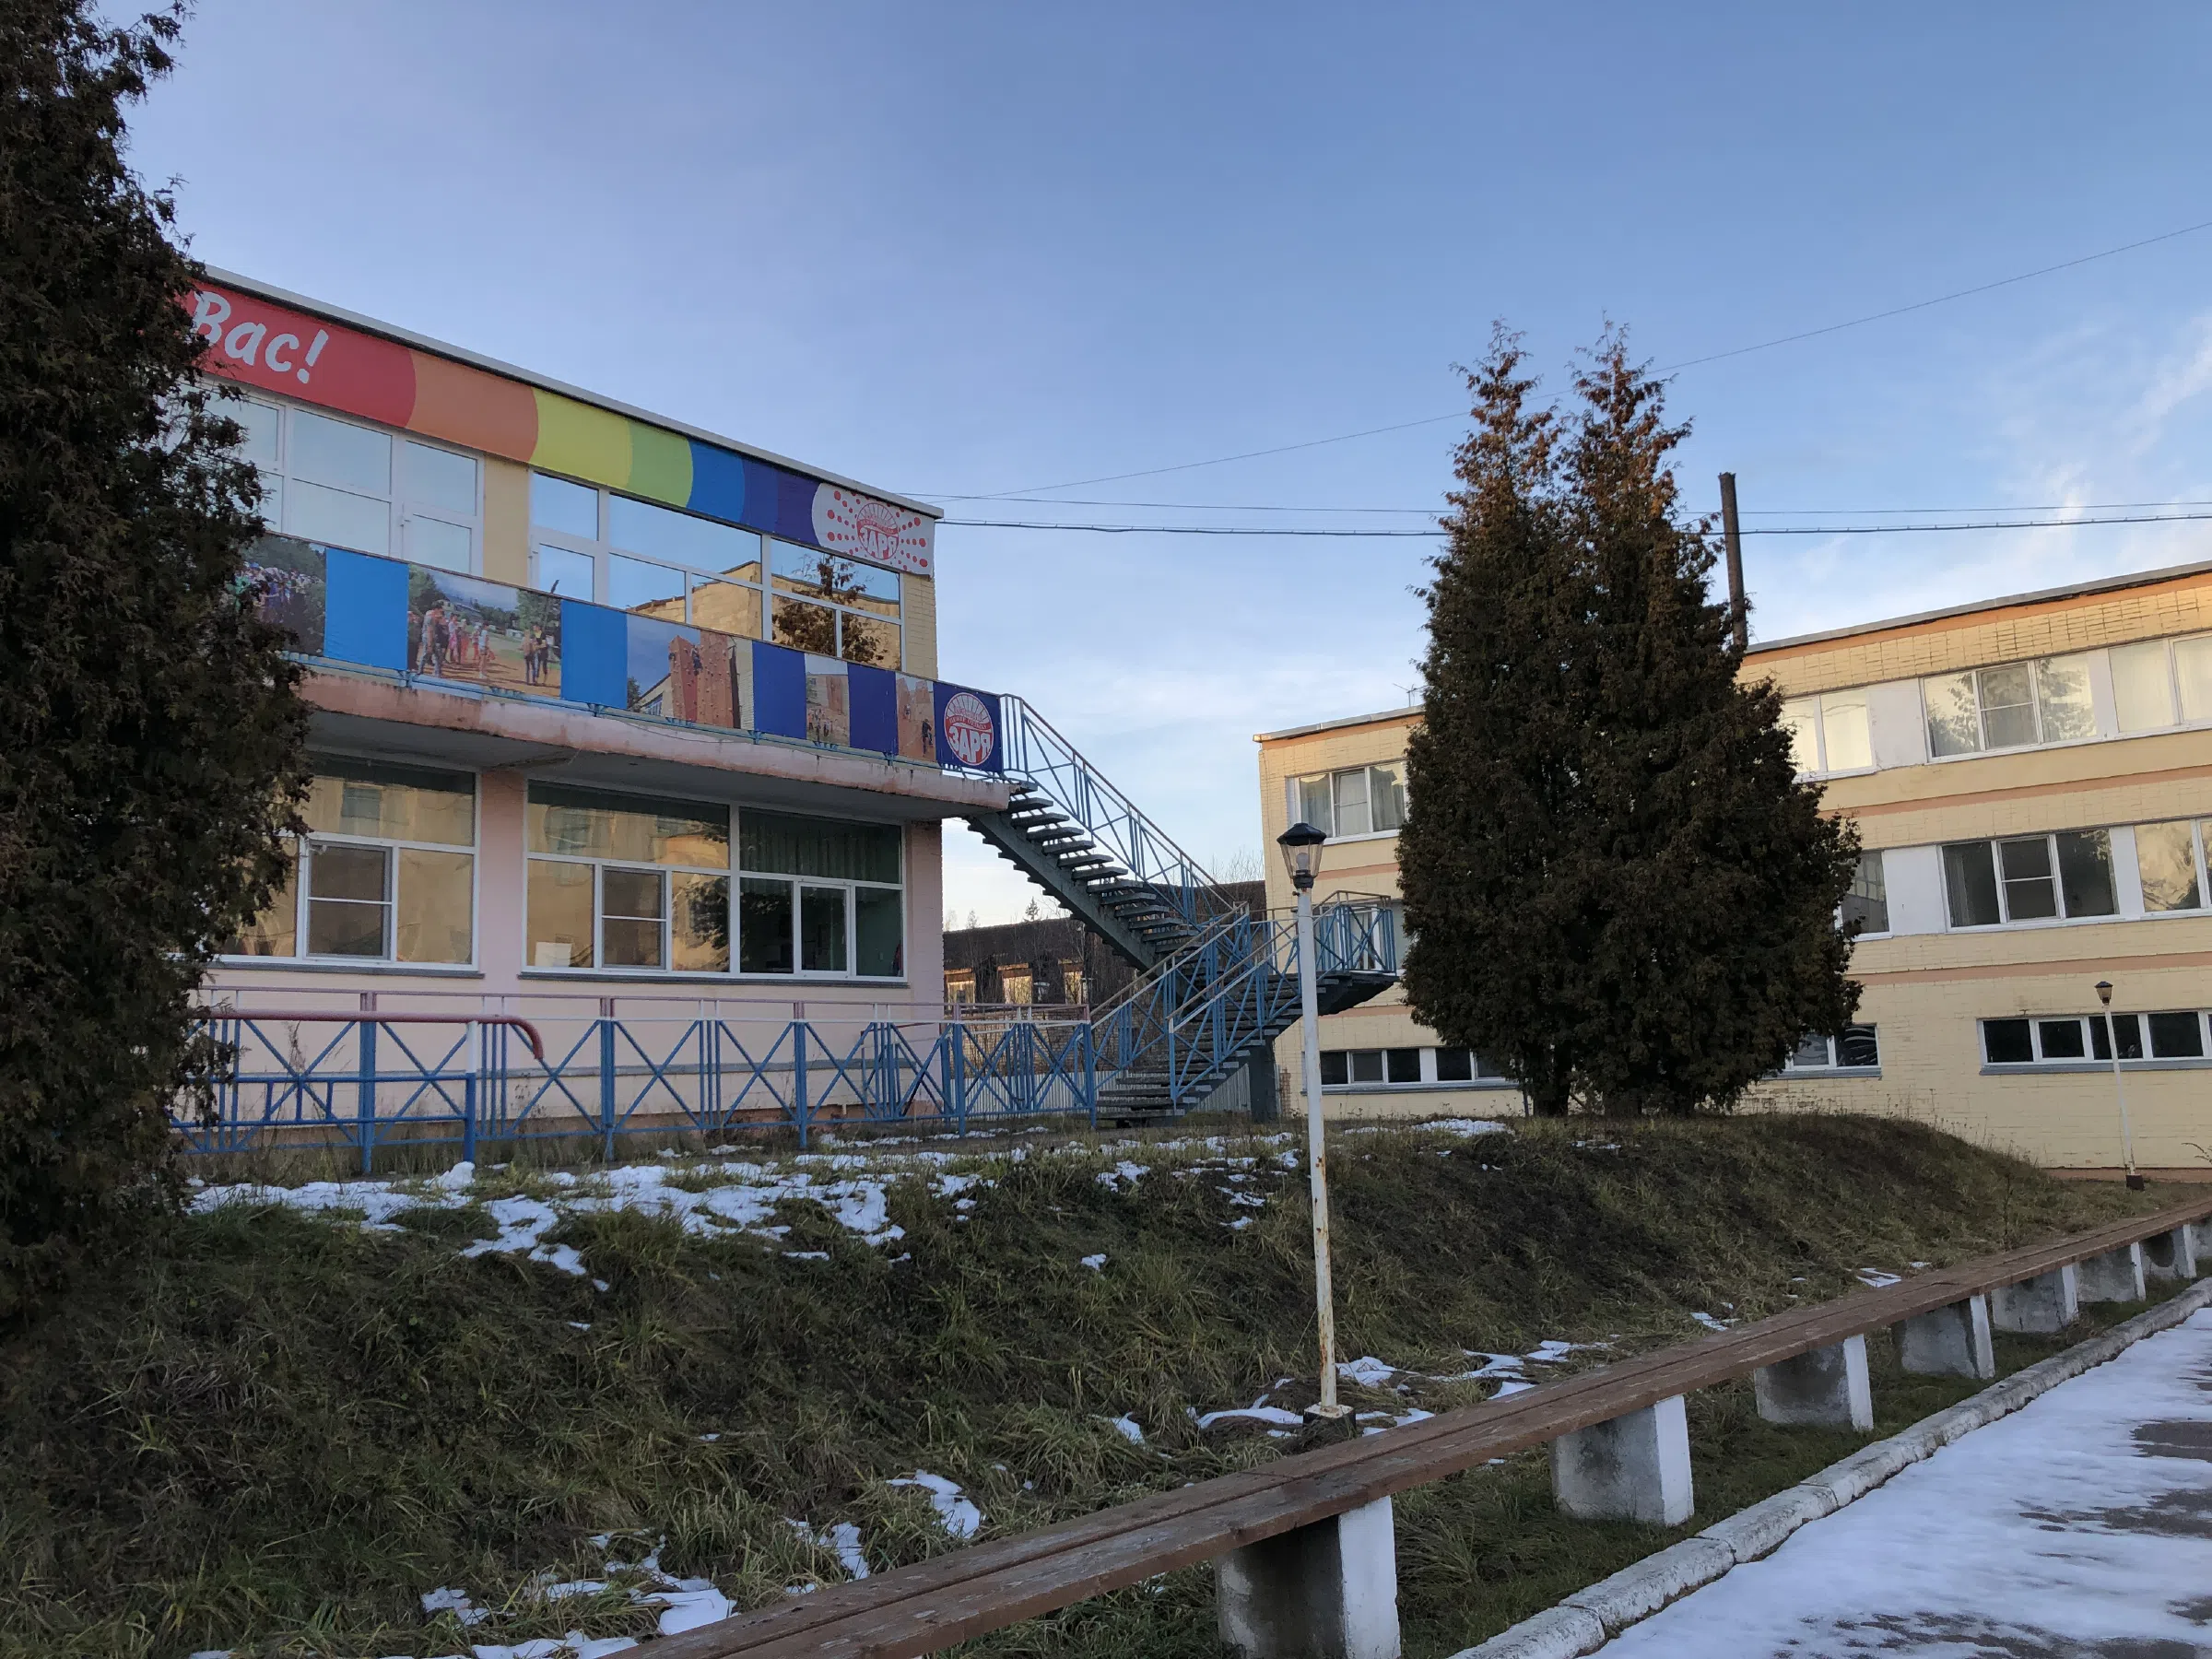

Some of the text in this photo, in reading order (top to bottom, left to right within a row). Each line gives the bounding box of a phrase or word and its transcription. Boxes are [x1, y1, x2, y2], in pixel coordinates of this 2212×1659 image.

[193, 290, 329, 384] Вас!
[859, 527, 898, 559] ЗАРЯ
[948, 725, 991, 763] ЗАРЯ
